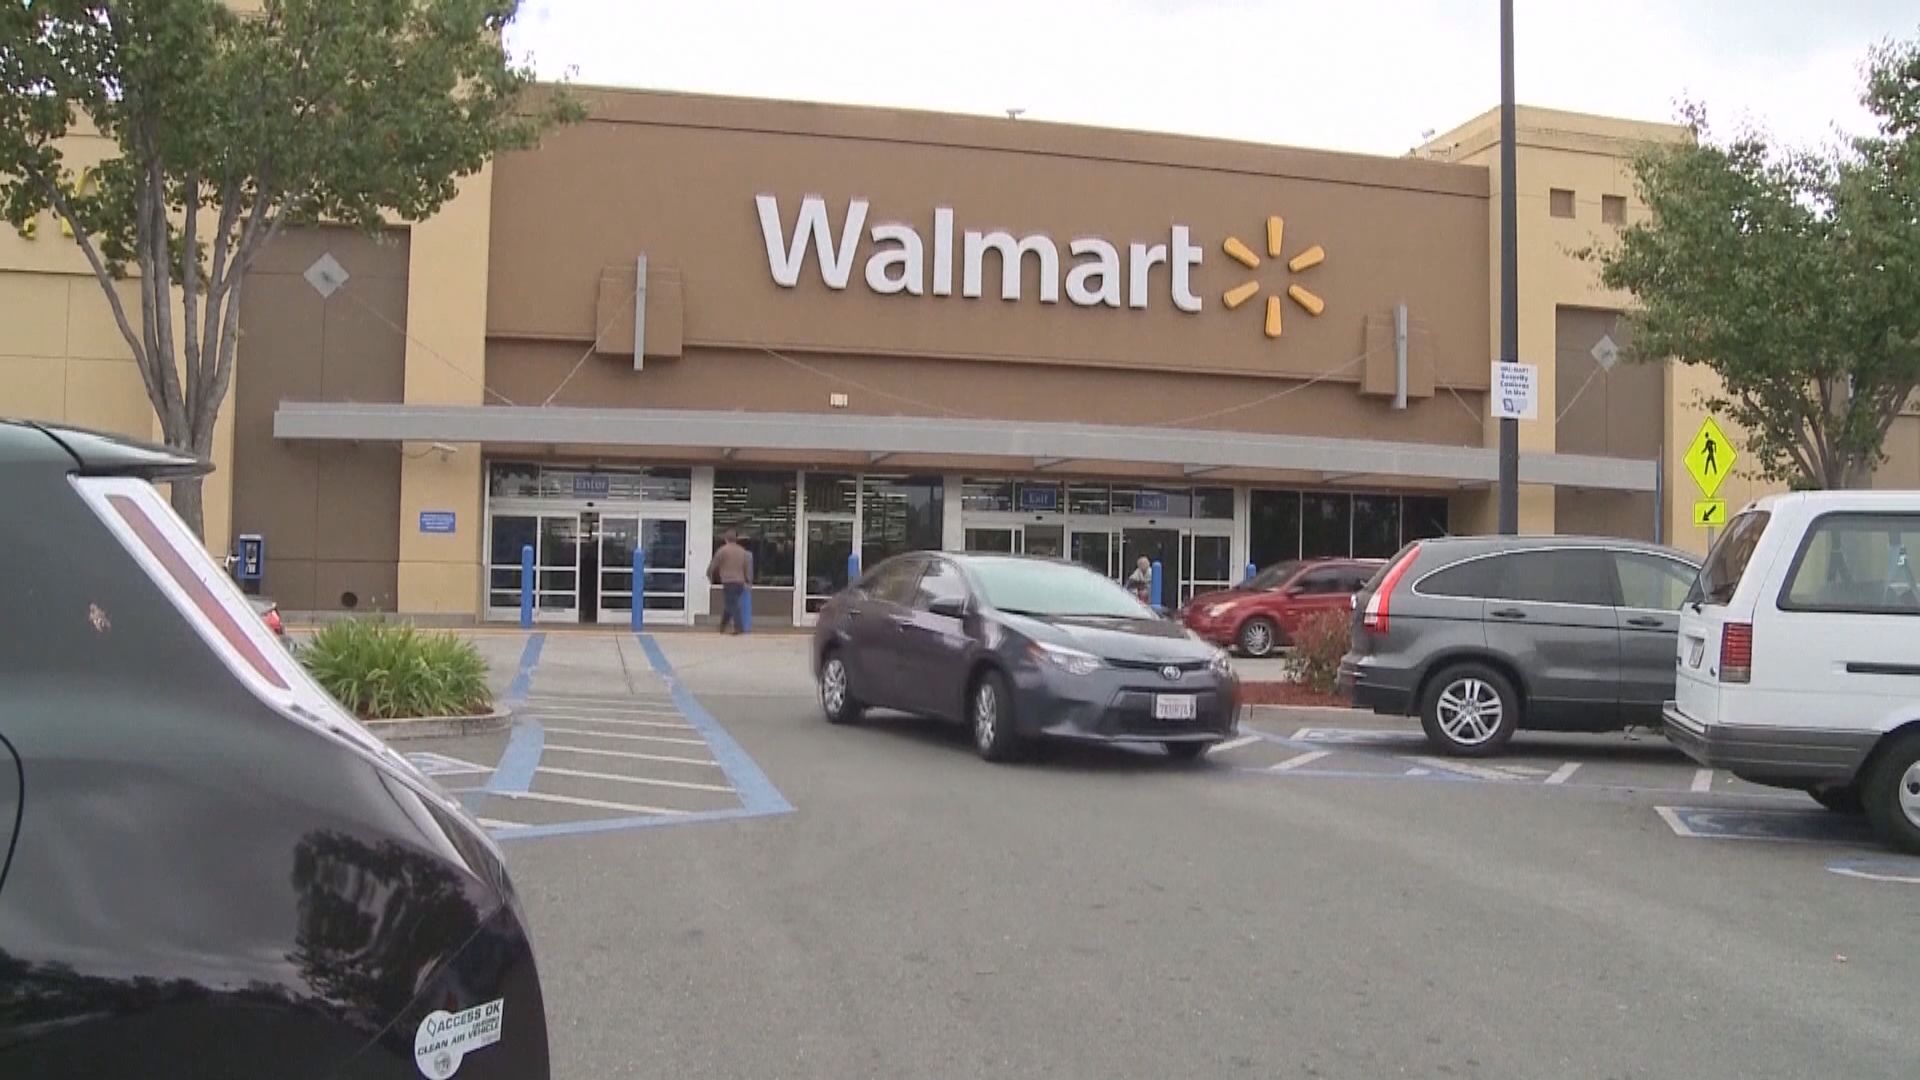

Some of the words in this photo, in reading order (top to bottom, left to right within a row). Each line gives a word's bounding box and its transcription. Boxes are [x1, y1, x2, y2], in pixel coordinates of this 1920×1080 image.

[756, 194, 1203, 312] Walmart
[575, 478, 606, 490] Enter
[1028, 493, 1048, 504] Exit
[1142, 497, 1161, 508] Exit
[437, 1008, 481, 1033] ACCESS
[486, 1002, 500, 1016] OK
[418, 1039, 448, 1056] CLEAN
[451, 1034, 465, 1045] AIR
[468, 1022, 498, 1039] VEHICLE
